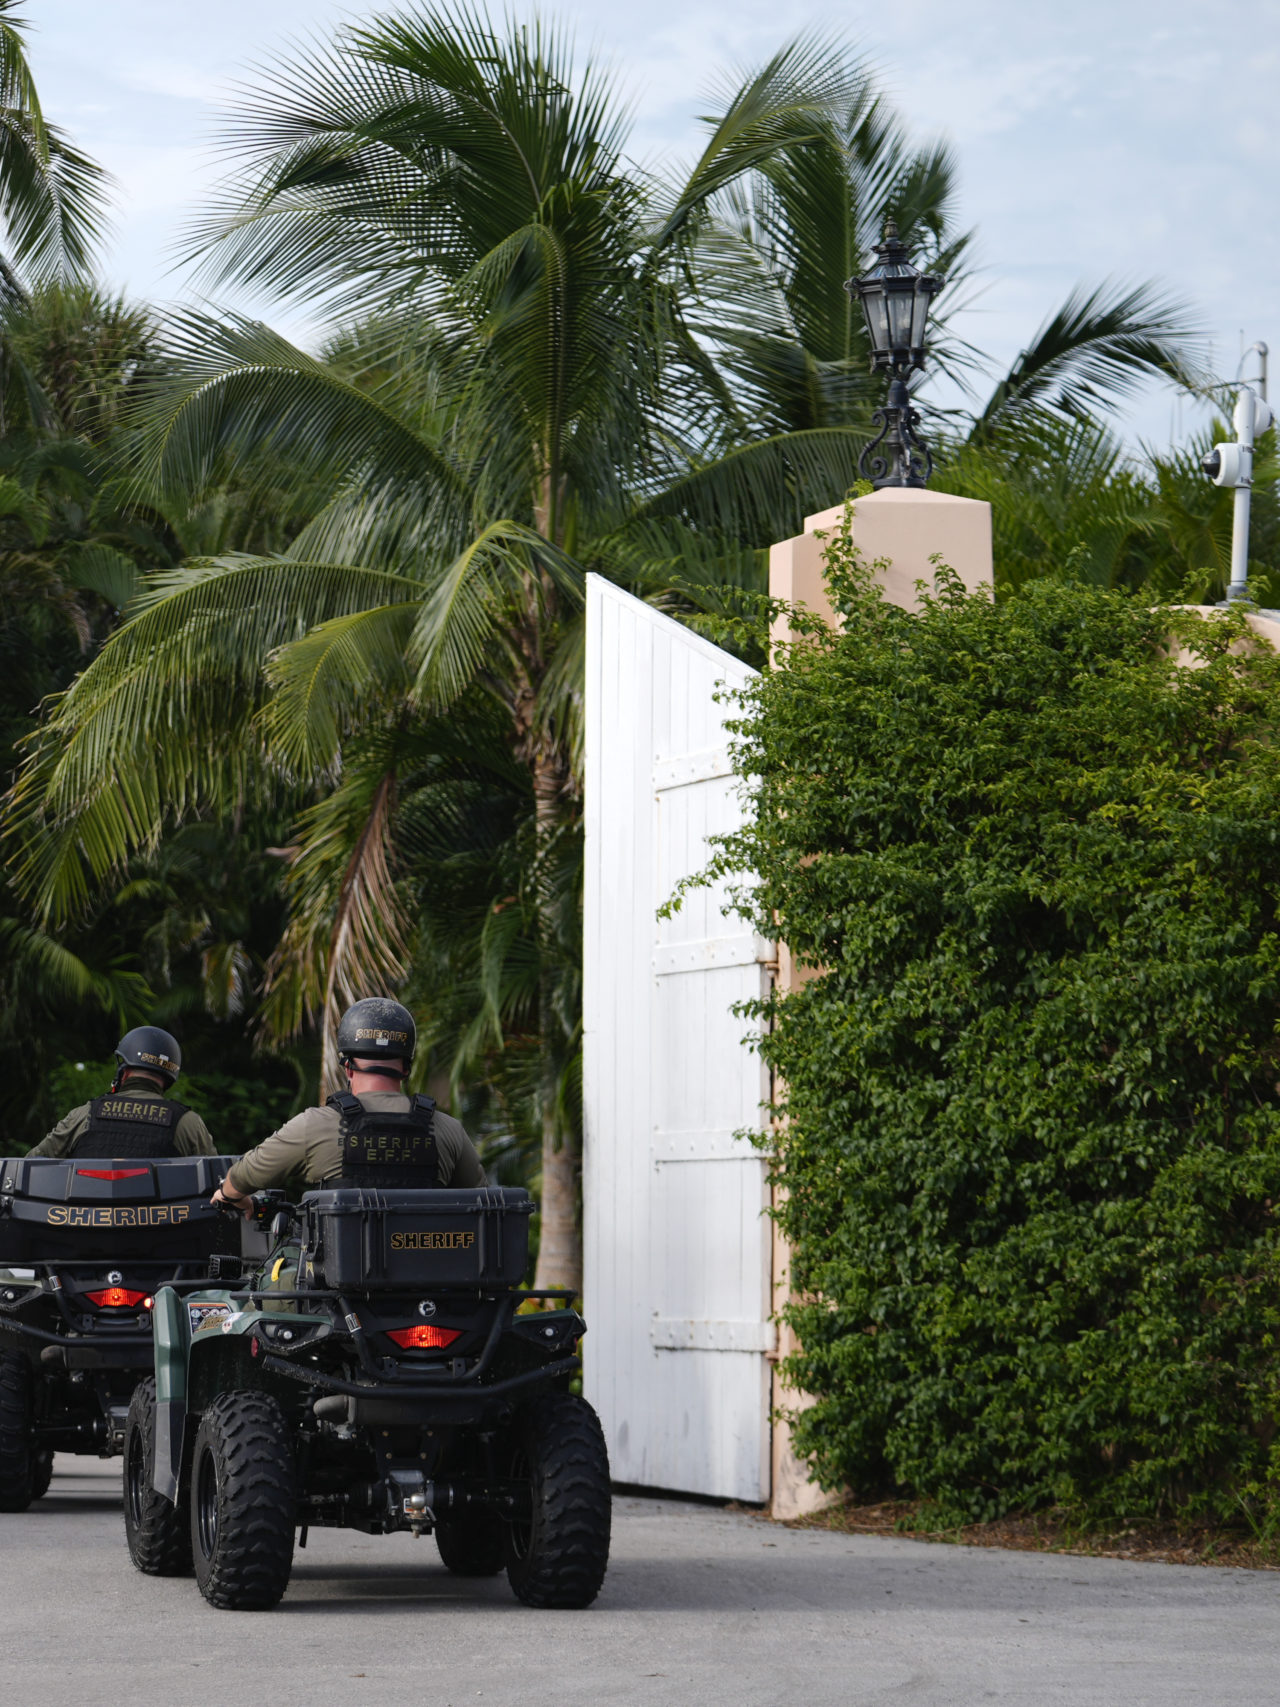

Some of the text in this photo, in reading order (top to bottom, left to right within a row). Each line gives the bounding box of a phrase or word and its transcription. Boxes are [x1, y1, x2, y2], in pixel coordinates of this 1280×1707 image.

[355, 1028, 408, 1043] SHERIFF
[102, 1101, 169, 1118] SHERIFF
[349, 1135, 432, 1149] SHERIFF
[366, 1149, 416, 1161] E.F.F.
[47, 1205, 190, 1227] SHERIFF
[391, 1232, 475, 1249] SHERIFF
